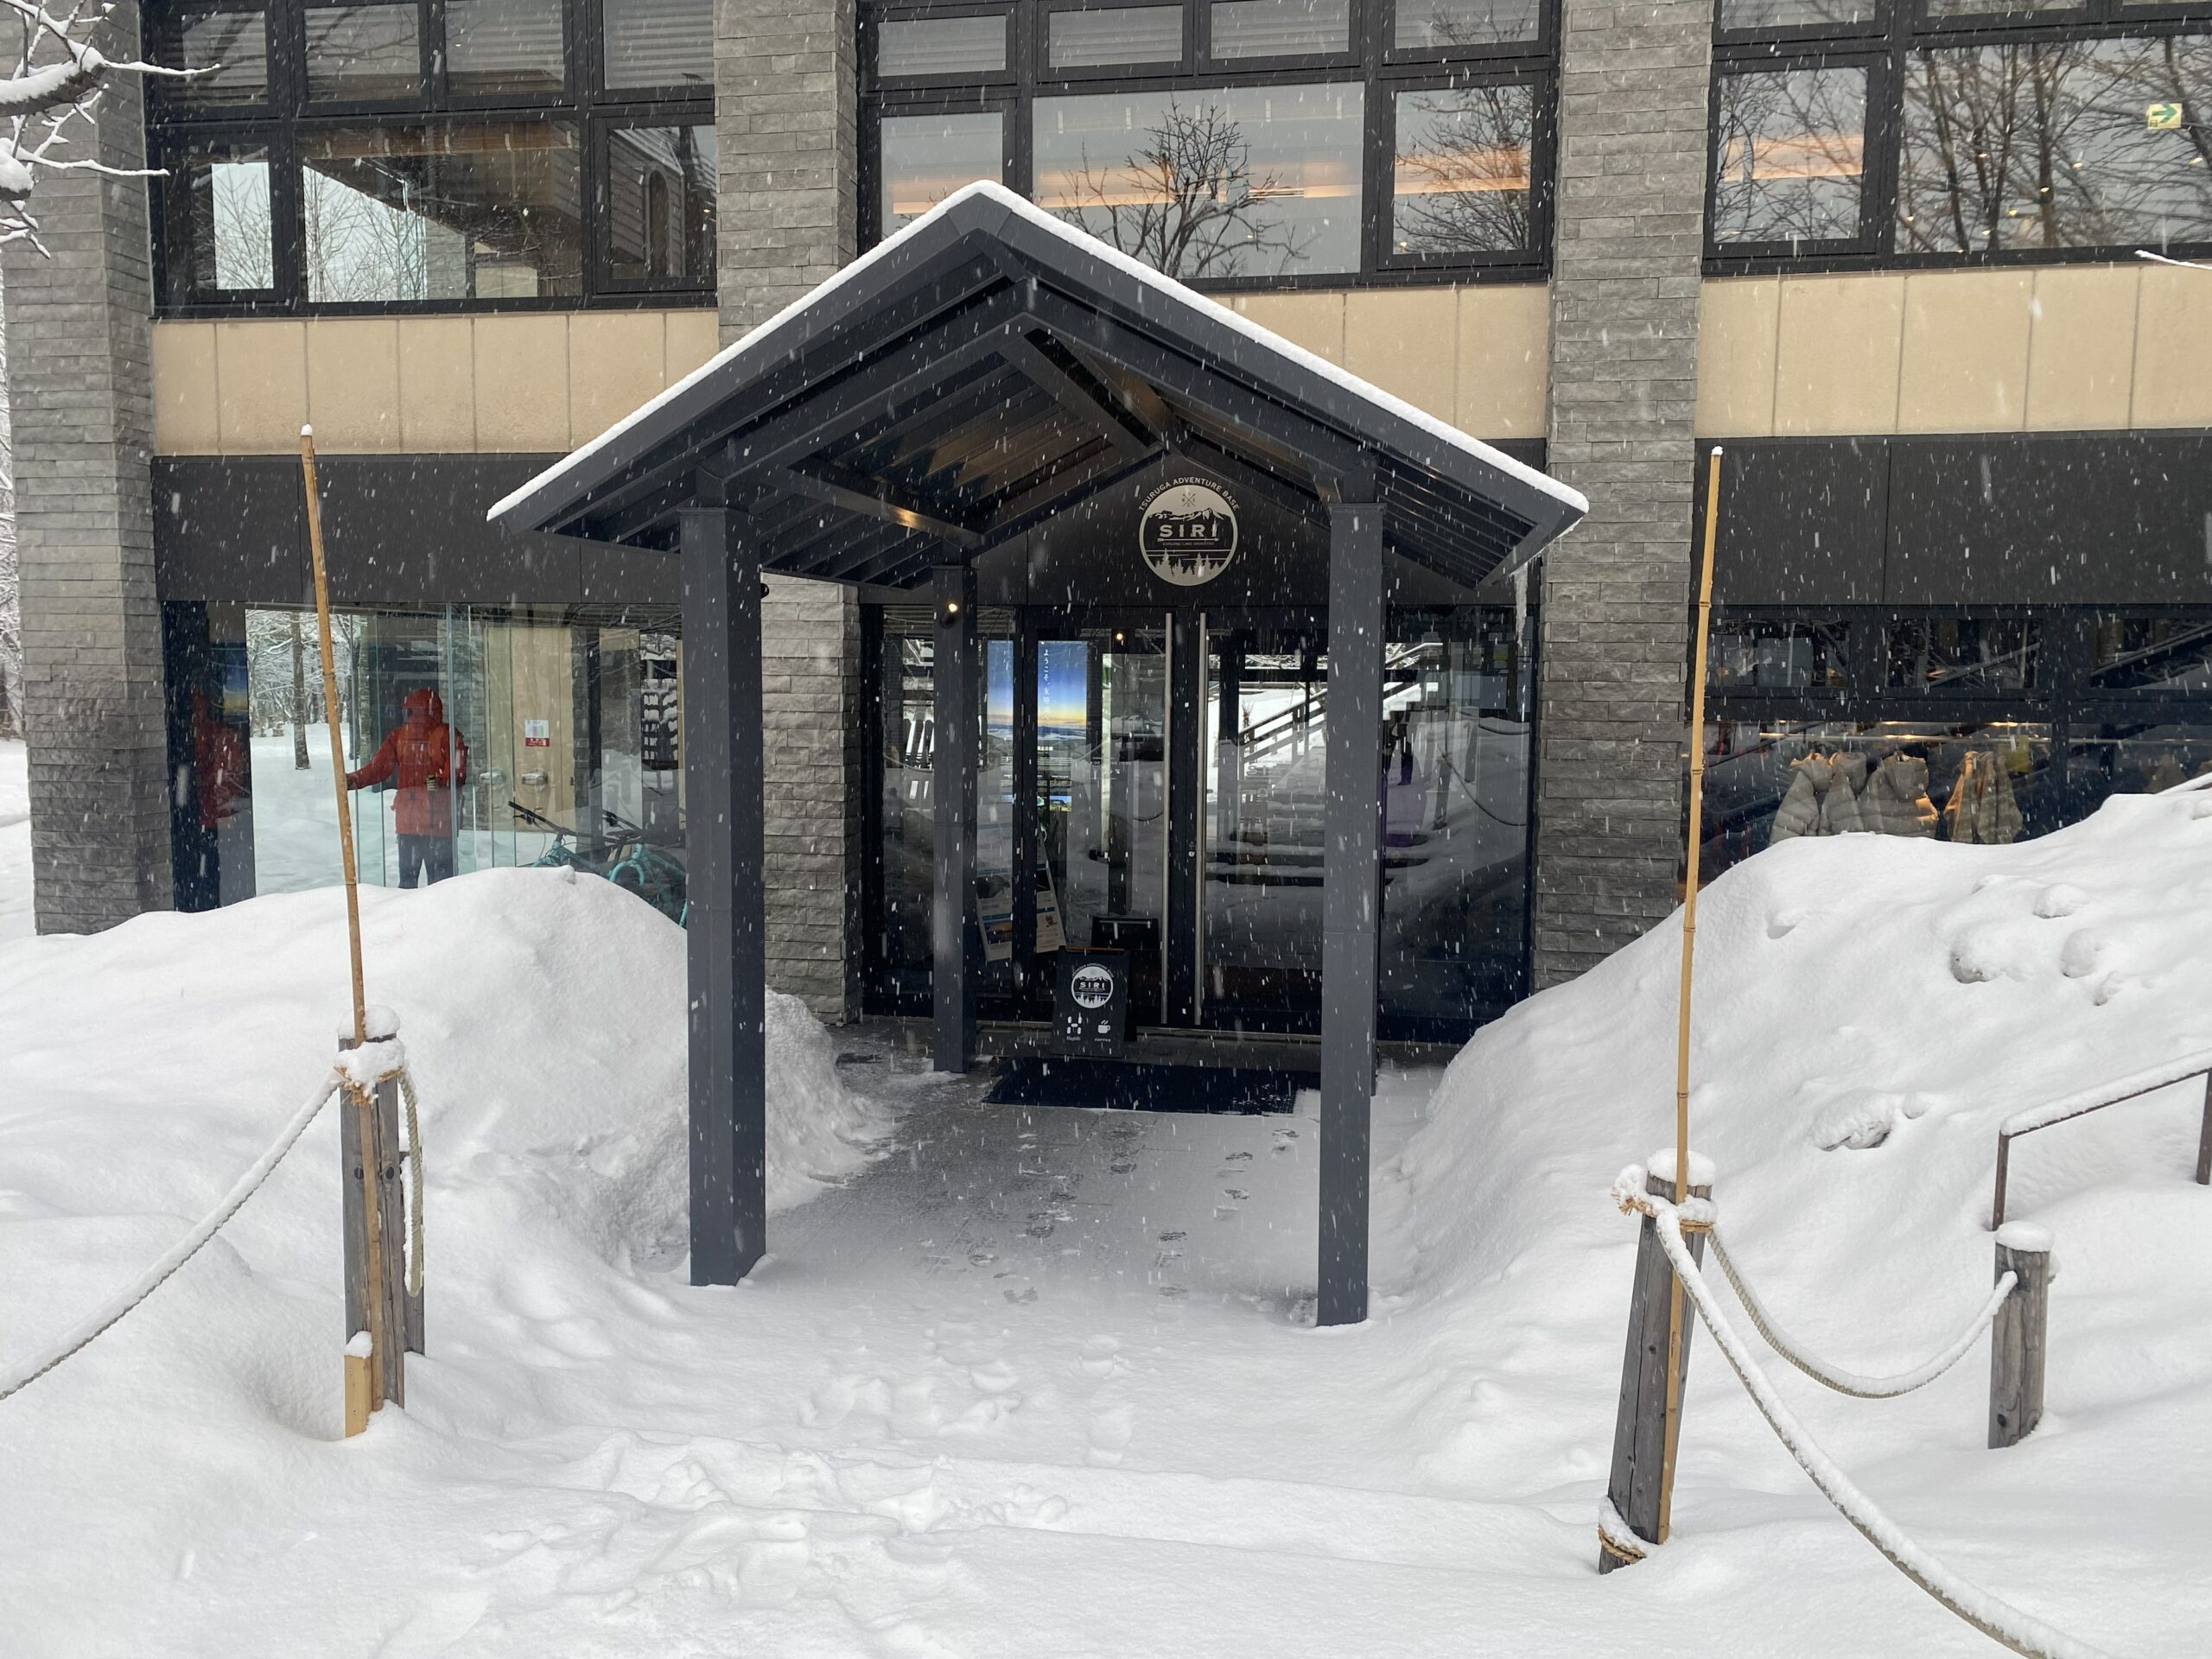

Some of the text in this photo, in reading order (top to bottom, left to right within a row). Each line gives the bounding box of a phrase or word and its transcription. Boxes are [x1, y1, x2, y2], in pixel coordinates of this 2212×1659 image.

[1139, 481, 1171, 512] TSURUGA
[1173, 476, 1223, 493] ADVENTURE
[1222, 490, 1239, 512] BASE
[1159, 524, 1217, 537] SIRI
